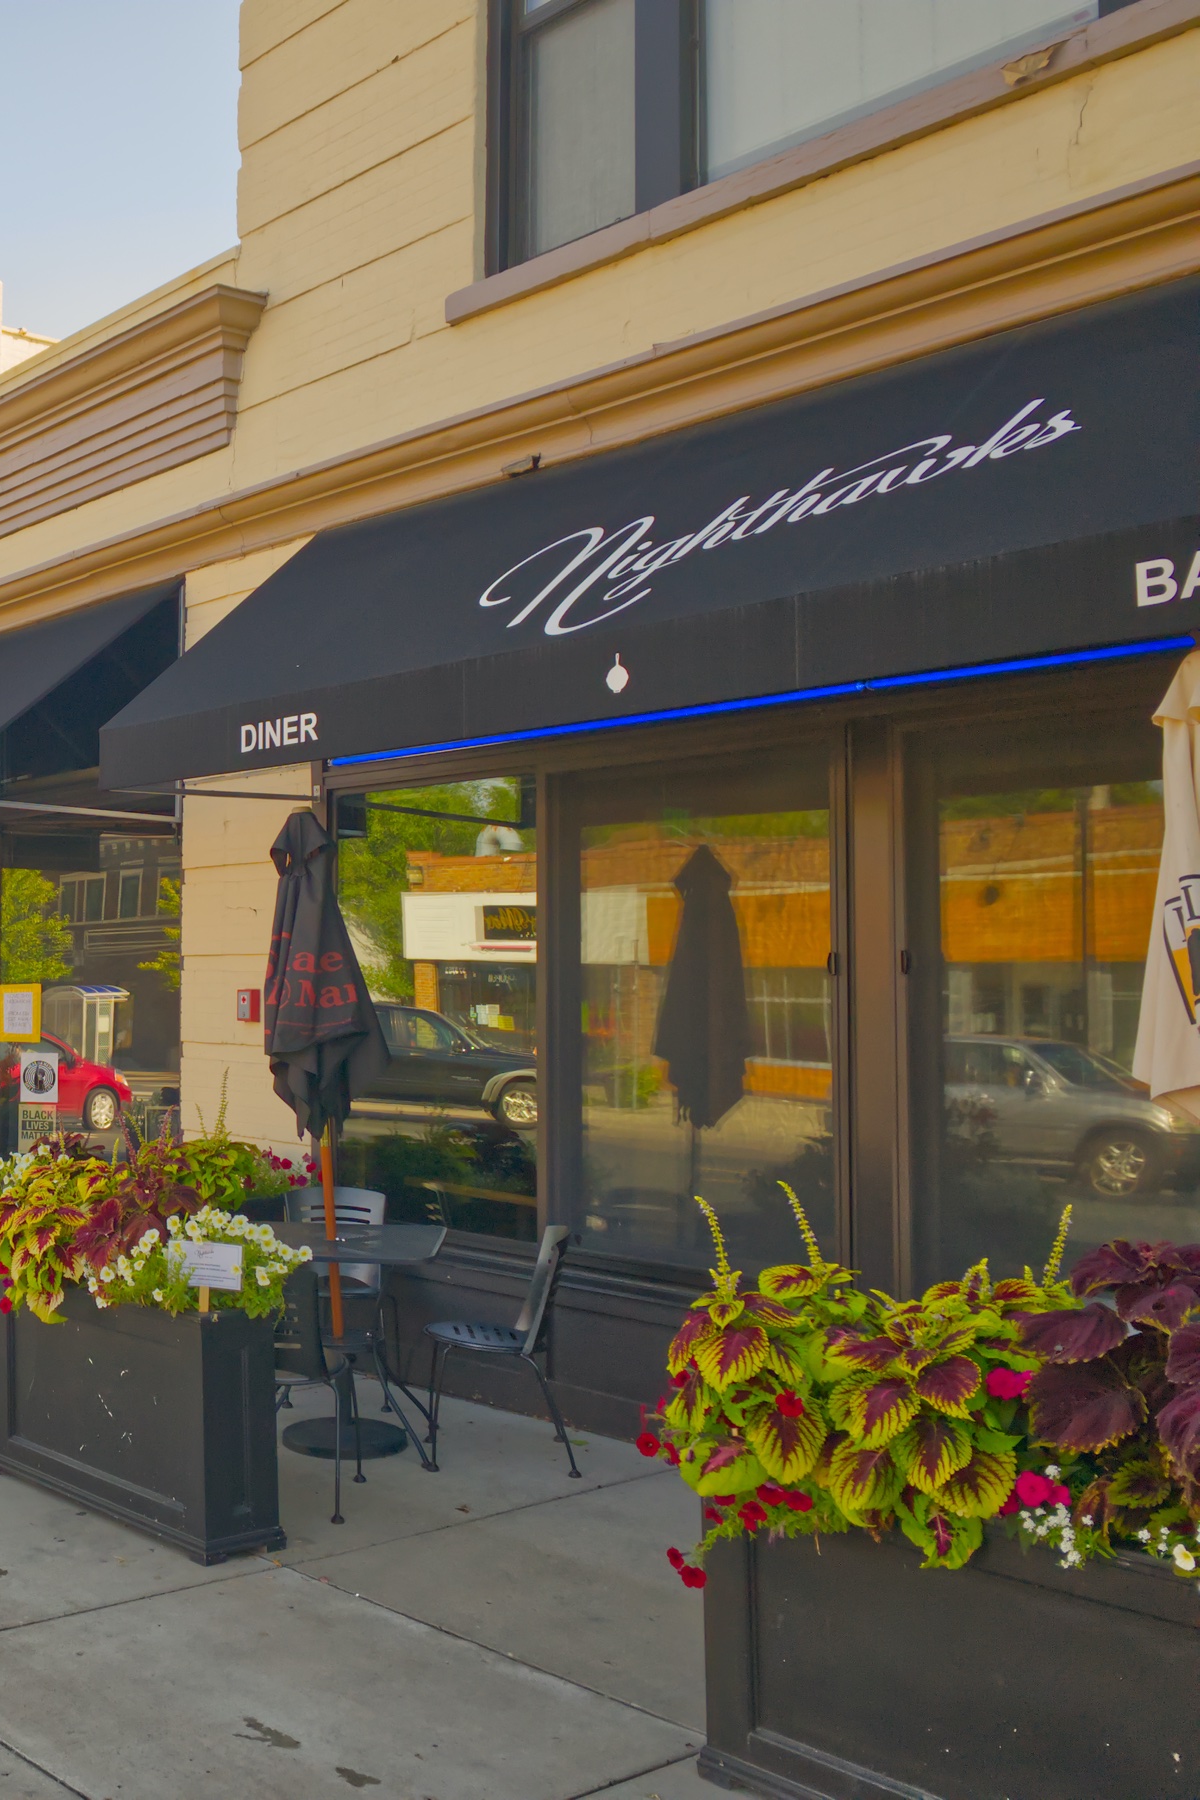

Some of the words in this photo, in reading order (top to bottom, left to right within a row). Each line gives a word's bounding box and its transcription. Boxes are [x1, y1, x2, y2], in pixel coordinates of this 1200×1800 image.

[479, 398, 1082, 636] Nighthawks
[240, 712, 319, 754] DINER
[22, 1110, 54, 1120] BLACK
[26, 1121, 50, 1130] LIVES
[21, 1131, 54, 1140] MATTE
